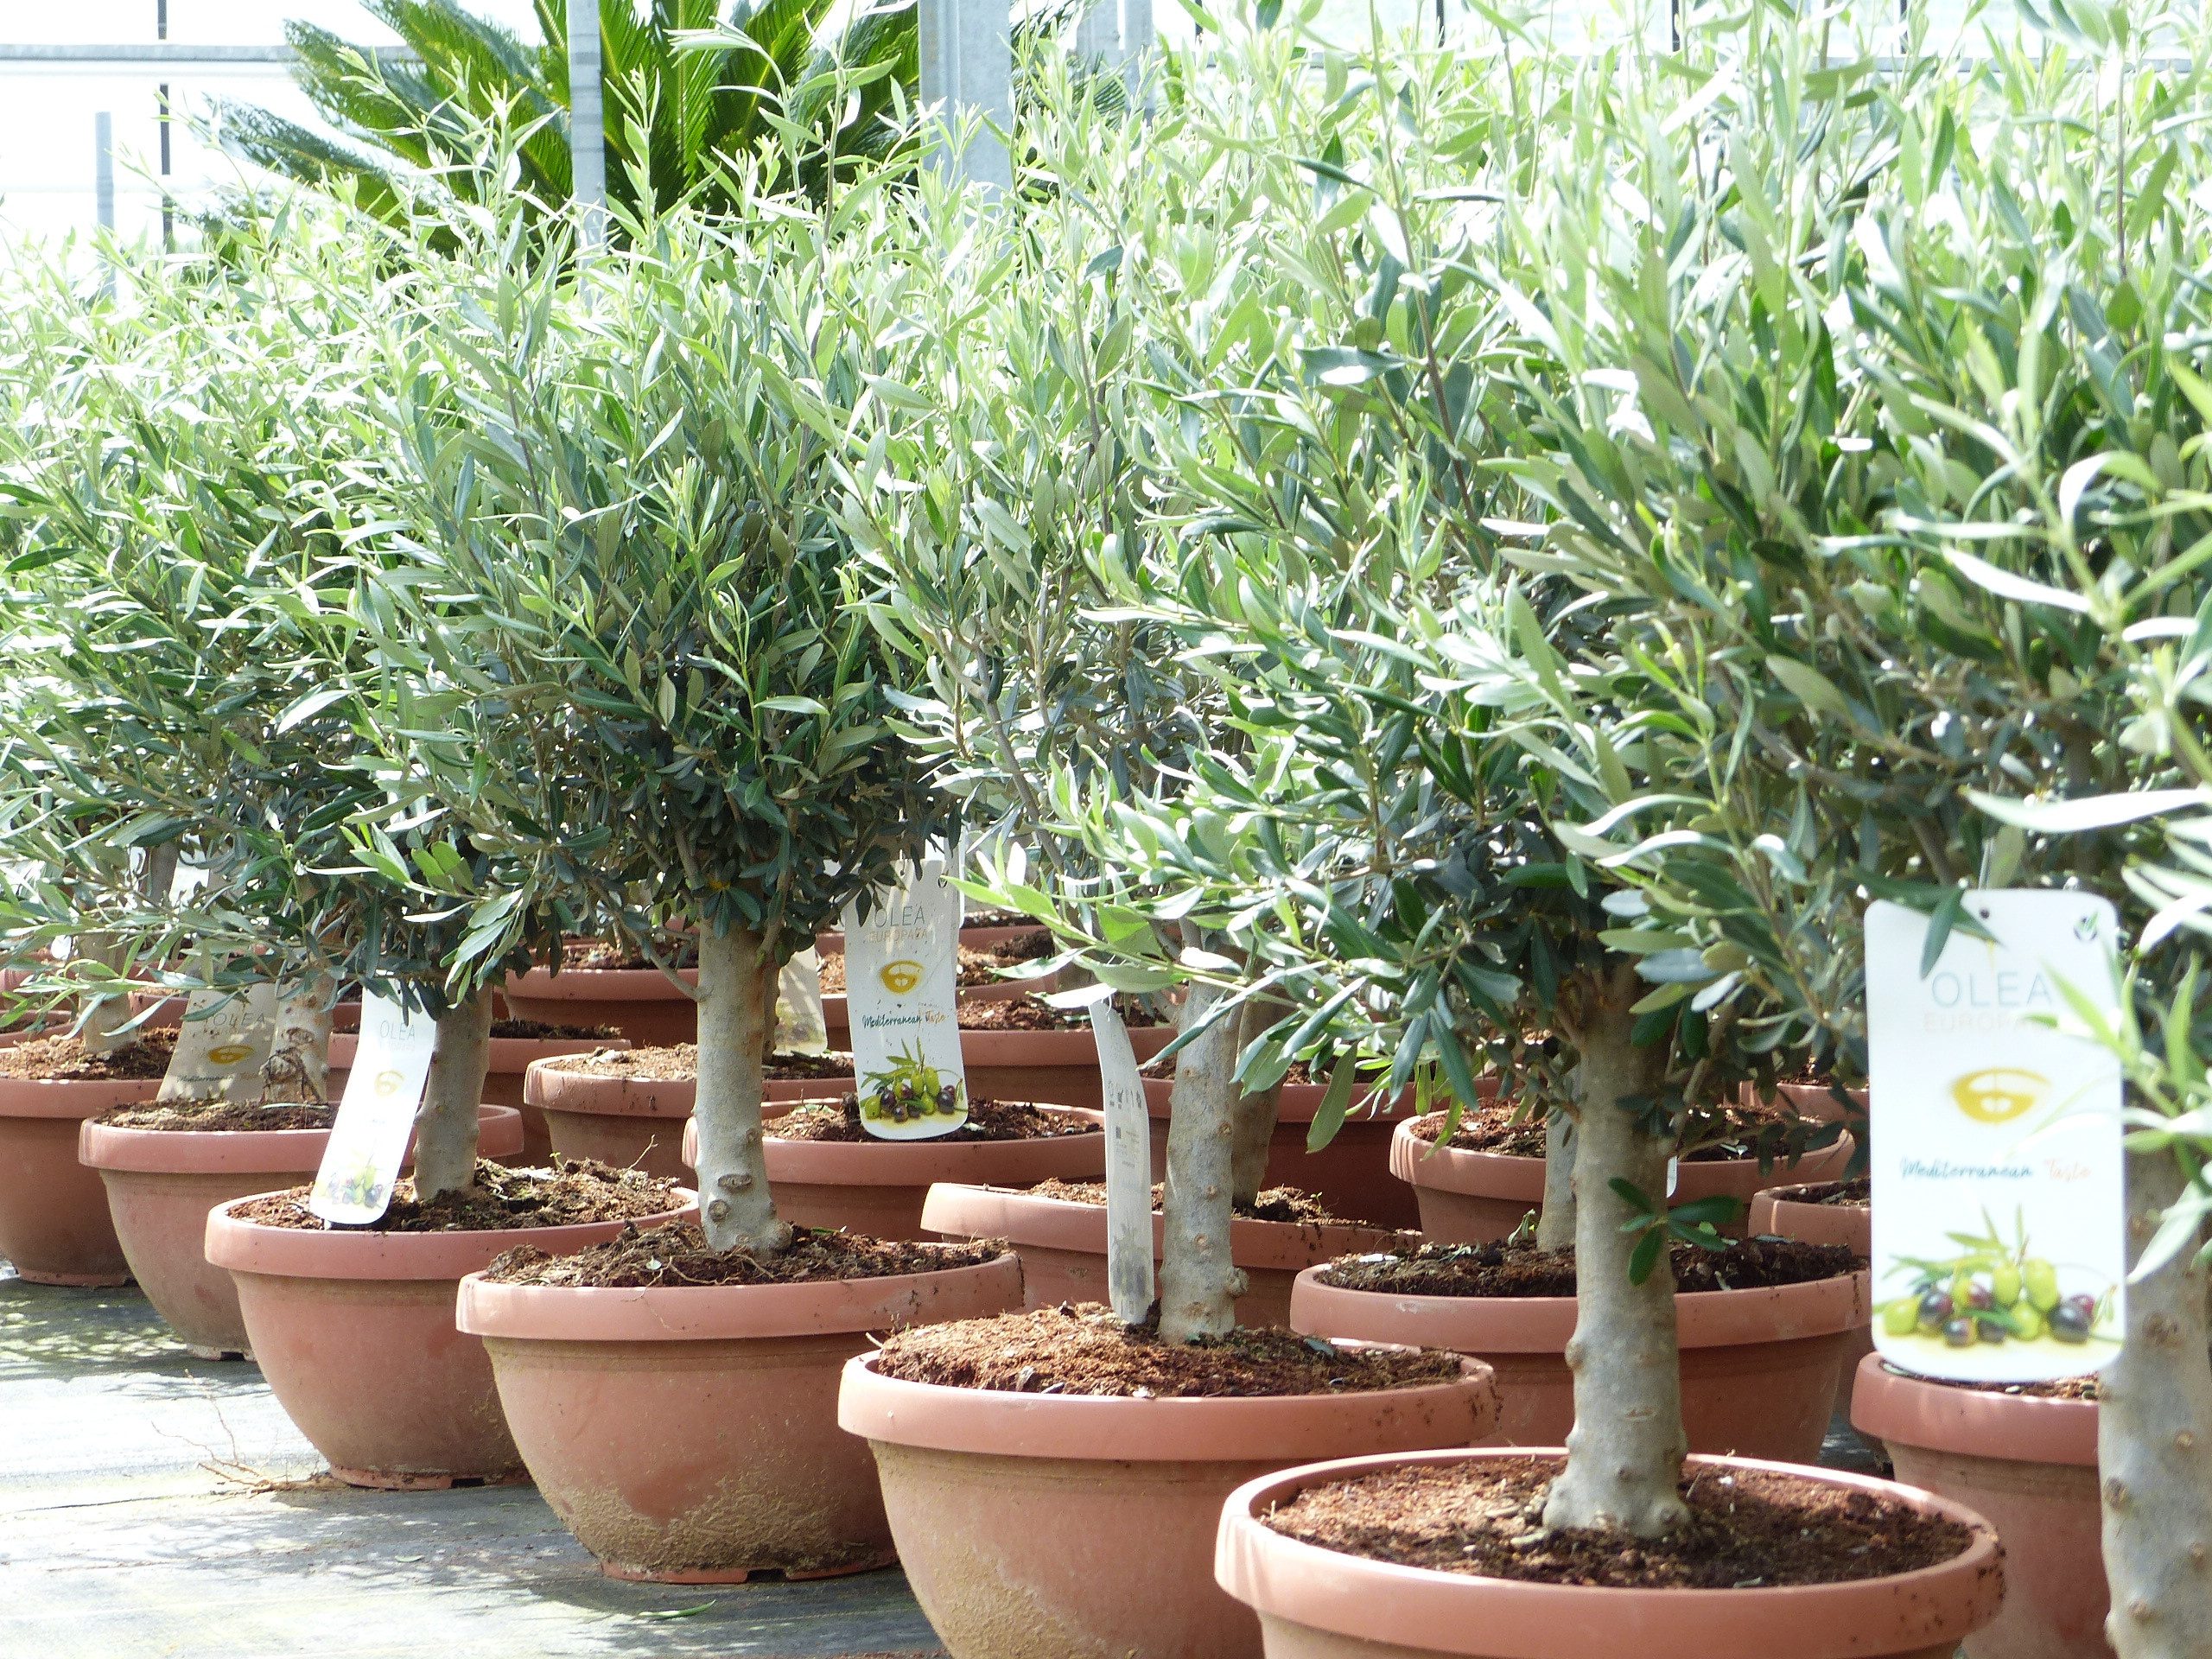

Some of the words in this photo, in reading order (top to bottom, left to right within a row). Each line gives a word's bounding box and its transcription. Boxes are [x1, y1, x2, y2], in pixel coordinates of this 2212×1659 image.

[874, 906, 925, 928] OLEA
[1931, 971, 2052, 1007] OLEA
[213, 1013, 264, 1027] OLEA
[380, 1020, 415, 1040] OLEA
[862, 1014, 922, 1028] Mediterranean
[1900, 1155, 2033, 1180] Mediterranean
[2043, 1157, 2092, 1182] Taste
